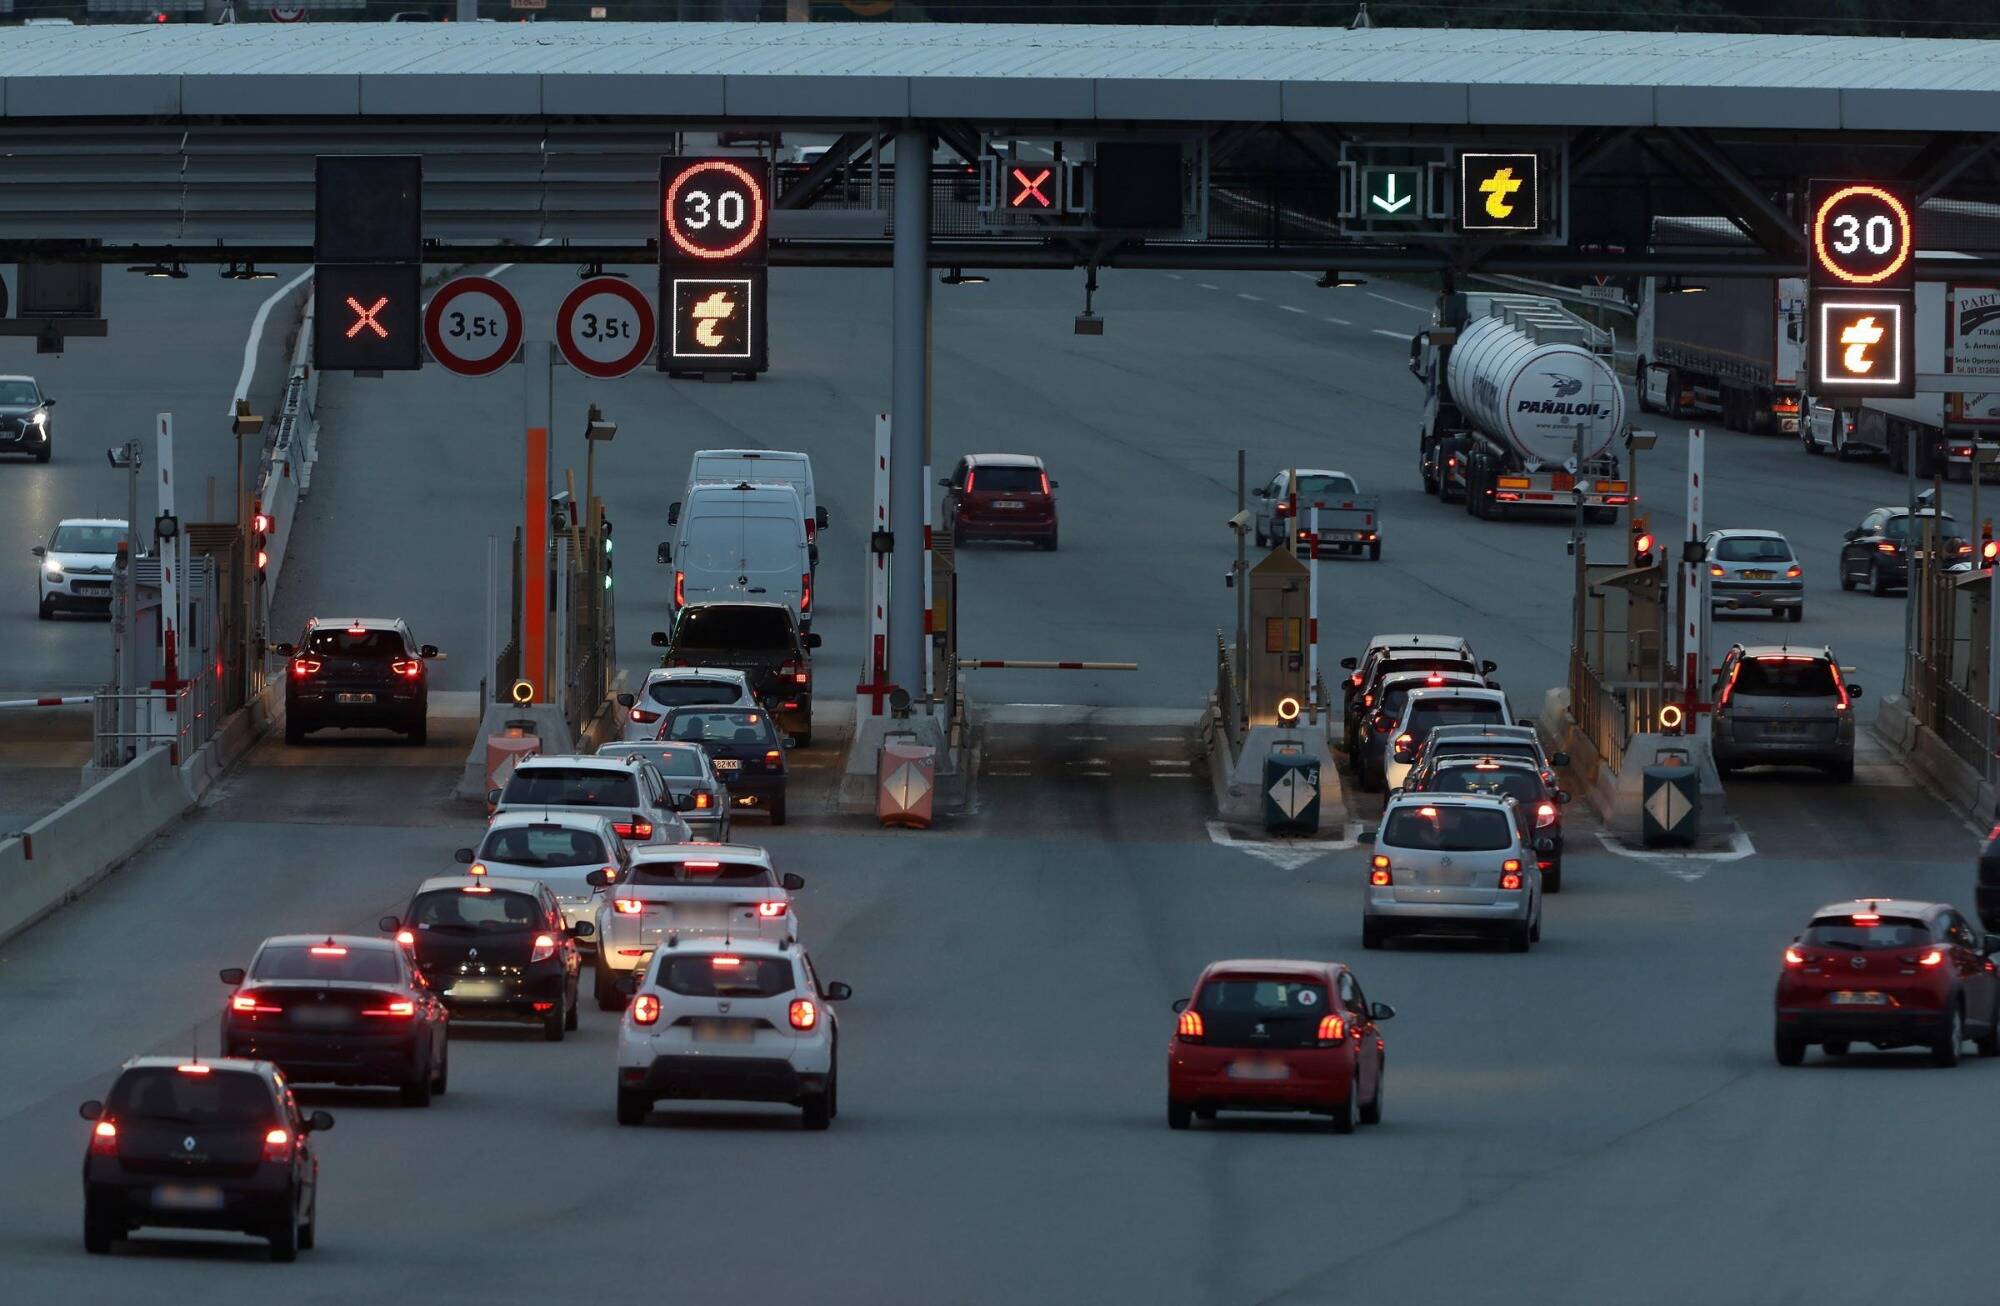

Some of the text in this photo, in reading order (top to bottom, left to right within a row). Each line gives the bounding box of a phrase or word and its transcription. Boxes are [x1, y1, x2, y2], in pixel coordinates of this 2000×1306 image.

[685, 190, 744, 229] 30
[1833, 214, 1893, 255] 30
[1518, 400, 1600, 415] PAÑALON
[1304, 992, 1312, 1002] A
